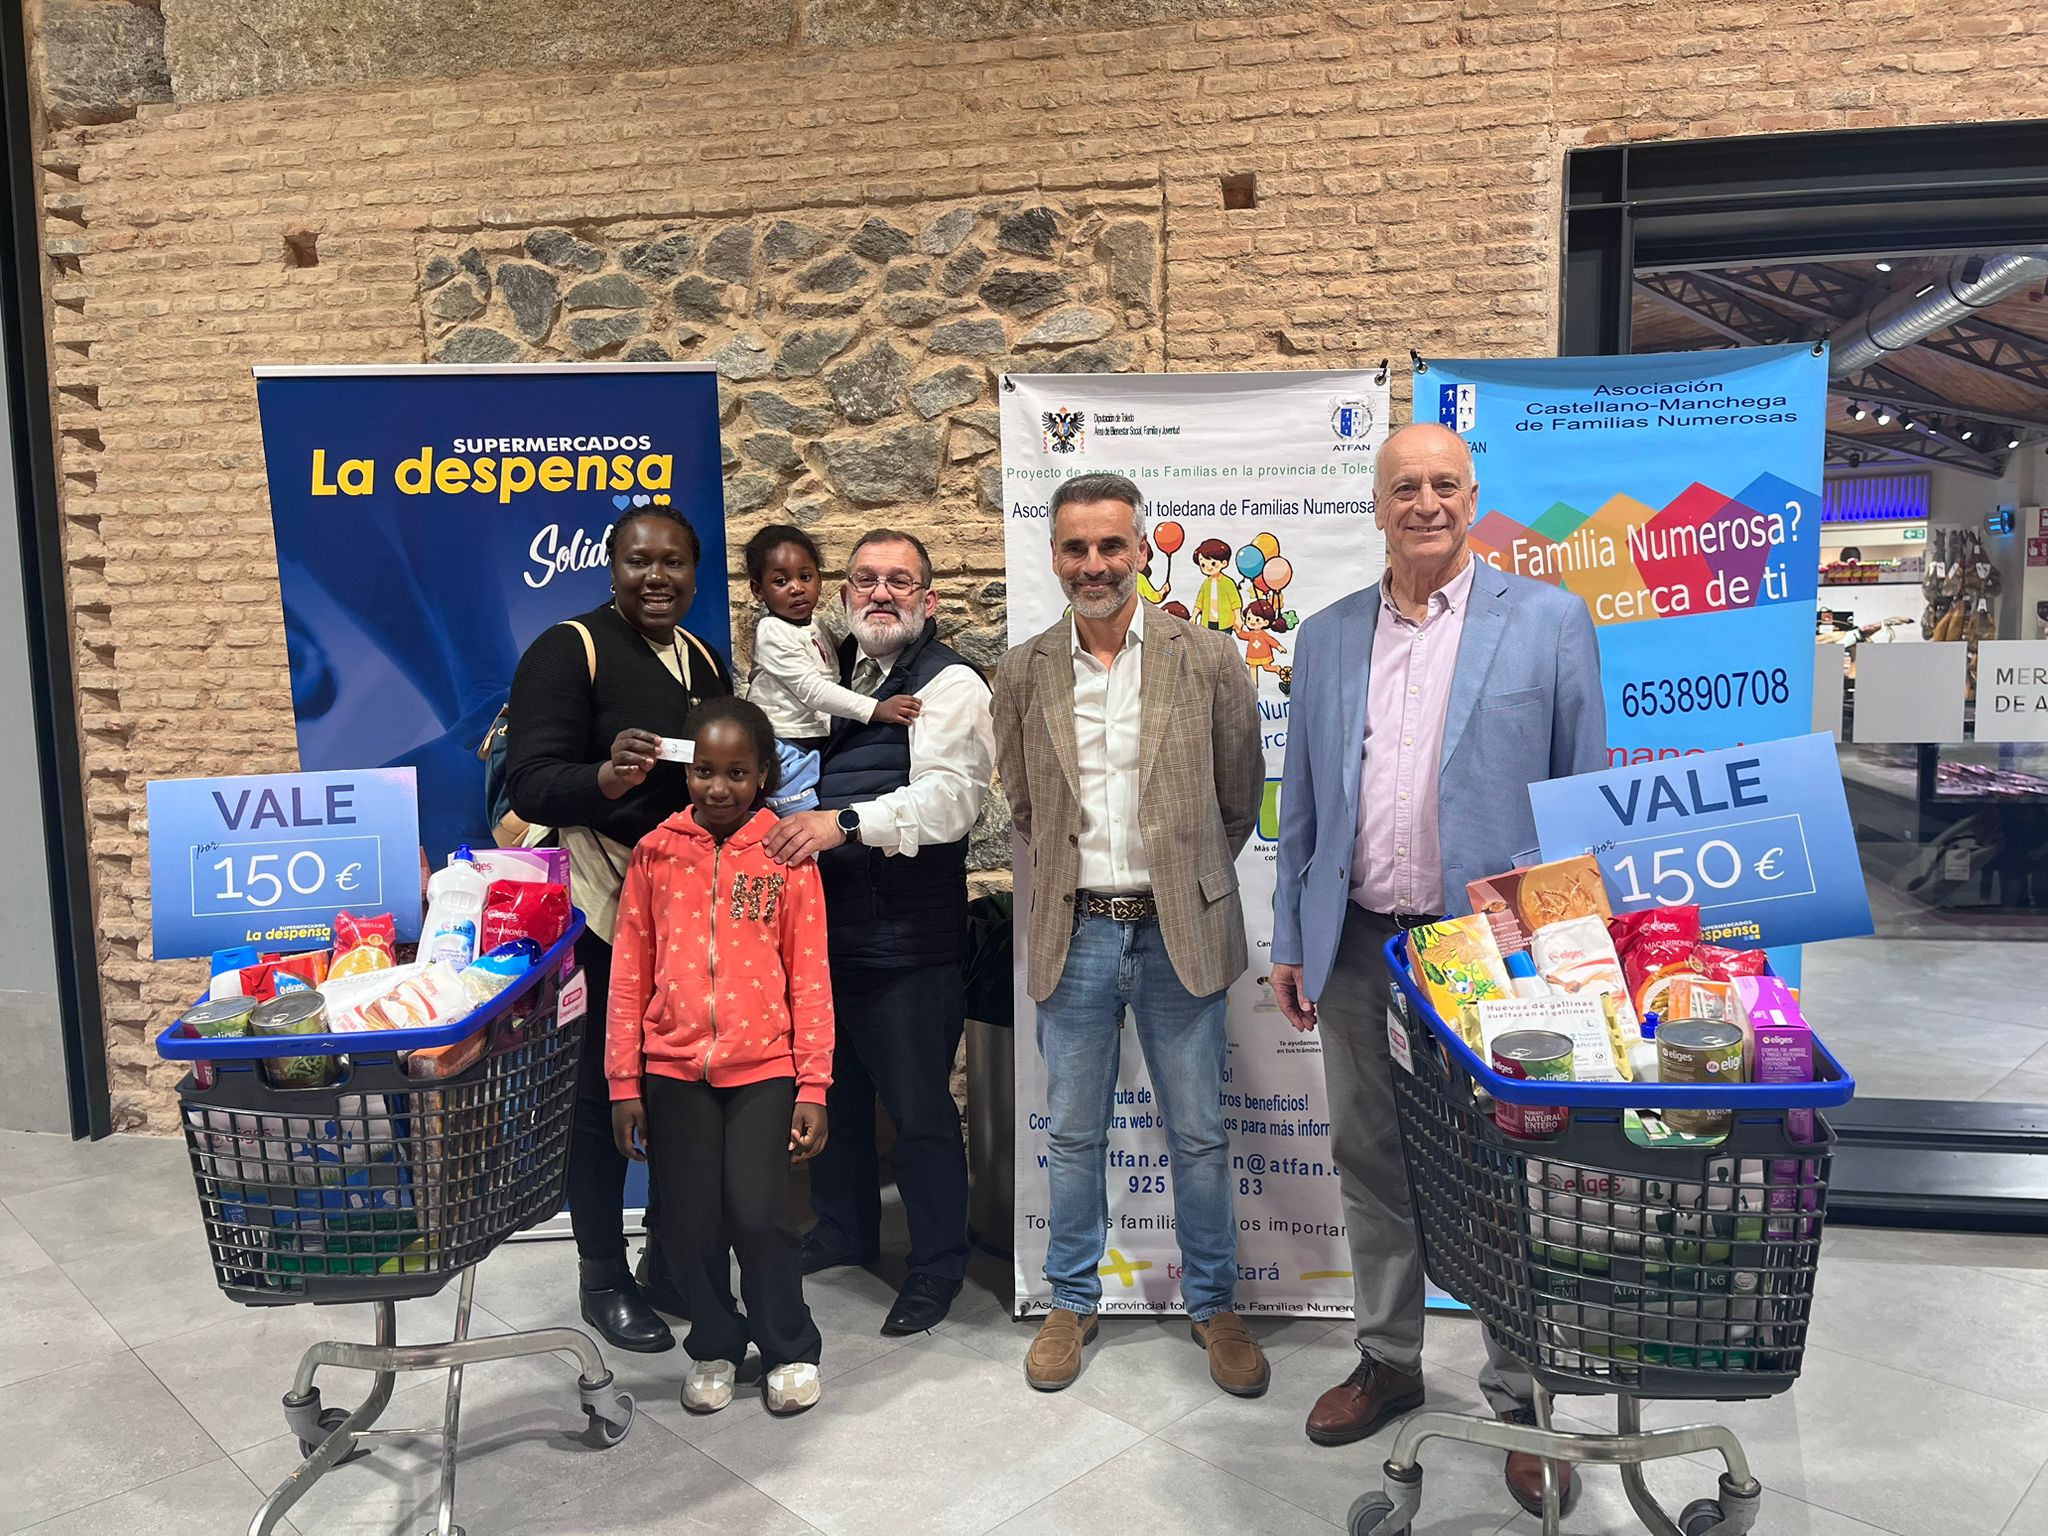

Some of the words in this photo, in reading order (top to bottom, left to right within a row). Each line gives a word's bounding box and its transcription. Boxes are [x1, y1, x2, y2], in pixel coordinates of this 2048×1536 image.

[1593, 380, 1723, 397] Asociación
[1526, 395, 1787, 416] Castellano-Manchega
[1094, 413, 1114, 424] Diputación
[1115, 414, 1120, 422] de
[1121, 412, 1134, 422] Toledo
[1516, 419, 1544, 432] de
[1552, 415, 1648, 432] Familias
[1657, 411, 1798, 428] Numerosas
[1104, 426, 1110, 436] de
[1110, 426, 1129, 436] Bienestar
[1144, 426, 1158, 435] Familia
[1162, 426, 1180, 435] Juventud
[453, 435, 652, 454] SUPERMERCADOS
[311, 448, 374, 496] La
[394, 446, 674, 504] despensa
[1006, 467, 1062, 482] Proyecto
[1066, 466, 1080, 477] de
[1130, 468, 1136, 477] a
[1142, 466, 1159, 477] las
[1164, 466, 1217, 477] Familias
[1222, 467, 1237, 476] en
[1242, 465, 1253, 476] la
[1258, 464, 1316, 478] provincia
[1321, 464, 1336, 475] de
[1012, 502, 1049, 518] Asoci
[1157, 500, 1215, 517] toledana
[1220, 500, 1237, 516] de
[1242, 499, 1298, 515] Familias
[1304, 498, 1376, 515] Numerosa
[1512, 529, 1616, 576] Familia
[1626, 501, 1802, 563] Numerosa?
[523, 524, 612, 589] Solid
[1595, 584, 1690, 621] cerca
[1705, 568, 1749, 608] de
[1764, 564, 1788, 600] ti
[1996, 668, 2048, 685] MER
[1622, 668, 1790, 718] 653890708
[1995, 696, 2026, 712] DE
[2034, 696, 2048, 712] A
[672, 744, 678, 754] 3
[1598, 758, 1769, 827] VALE
[212, 784, 356, 831] VALE
[196, 840, 220, 860] por
[214, 850, 326, 907] 150
[335, 862, 362, 891] €
[1614, 839, 1742, 907] 150
[1753, 847, 1785, 881] €
[246, 930, 262, 942] La
[266, 928, 331, 941] despensa
[1700, 924, 1760, 942] espensa
[1644, 940, 1694, 952] MACARRONES
[1486, 1004, 1528, 1012] Huevos
[1550, 1000, 1594, 1009] gallinas
[1552, 1008, 1596, 1017] gallinero
[1771, 1036, 1794, 1046] eliges
[1668, 1050, 1694, 1062] eliges
[1720, 1056, 1742, 1071] elig
[1222, 1068, 1232, 1083] o!
[1138, 1086, 1151, 1104] de
[1219, 1090, 1241, 1107] tros
[1245, 1092, 1308, 1111] beneficios!
[1112, 1115, 1126, 1129] tra
[1130, 1112, 1152, 1128] web
[1224, 1117, 1237, 1130] os
[1241, 1120, 1266, 1135] para
[1270, 1120, 1294, 1136] más
[1298, 1118, 1330, 1136] infor
[1524, 1114, 1562, 1122] NATURAL
[1109, 1150, 1169, 1168] tfan.e
[1233, 1154, 1340, 1176] n@atfan.
[1129, 1176, 1165, 1194] 925
[1121, 1214, 1176, 1230] famili
[1240, 1219, 1261, 1231] os
[1269, 1217, 1346, 1237] importa
[1237, 1262, 1280, 1281] tará
[1106, 1301, 1166, 1312] provincial
[1170, 1302, 1185, 1311] tol
[1233, 1302, 1246, 1311] de
[1250, 1302, 1303, 1312] Familias
[1307, 1303, 1354, 1312] Numer
